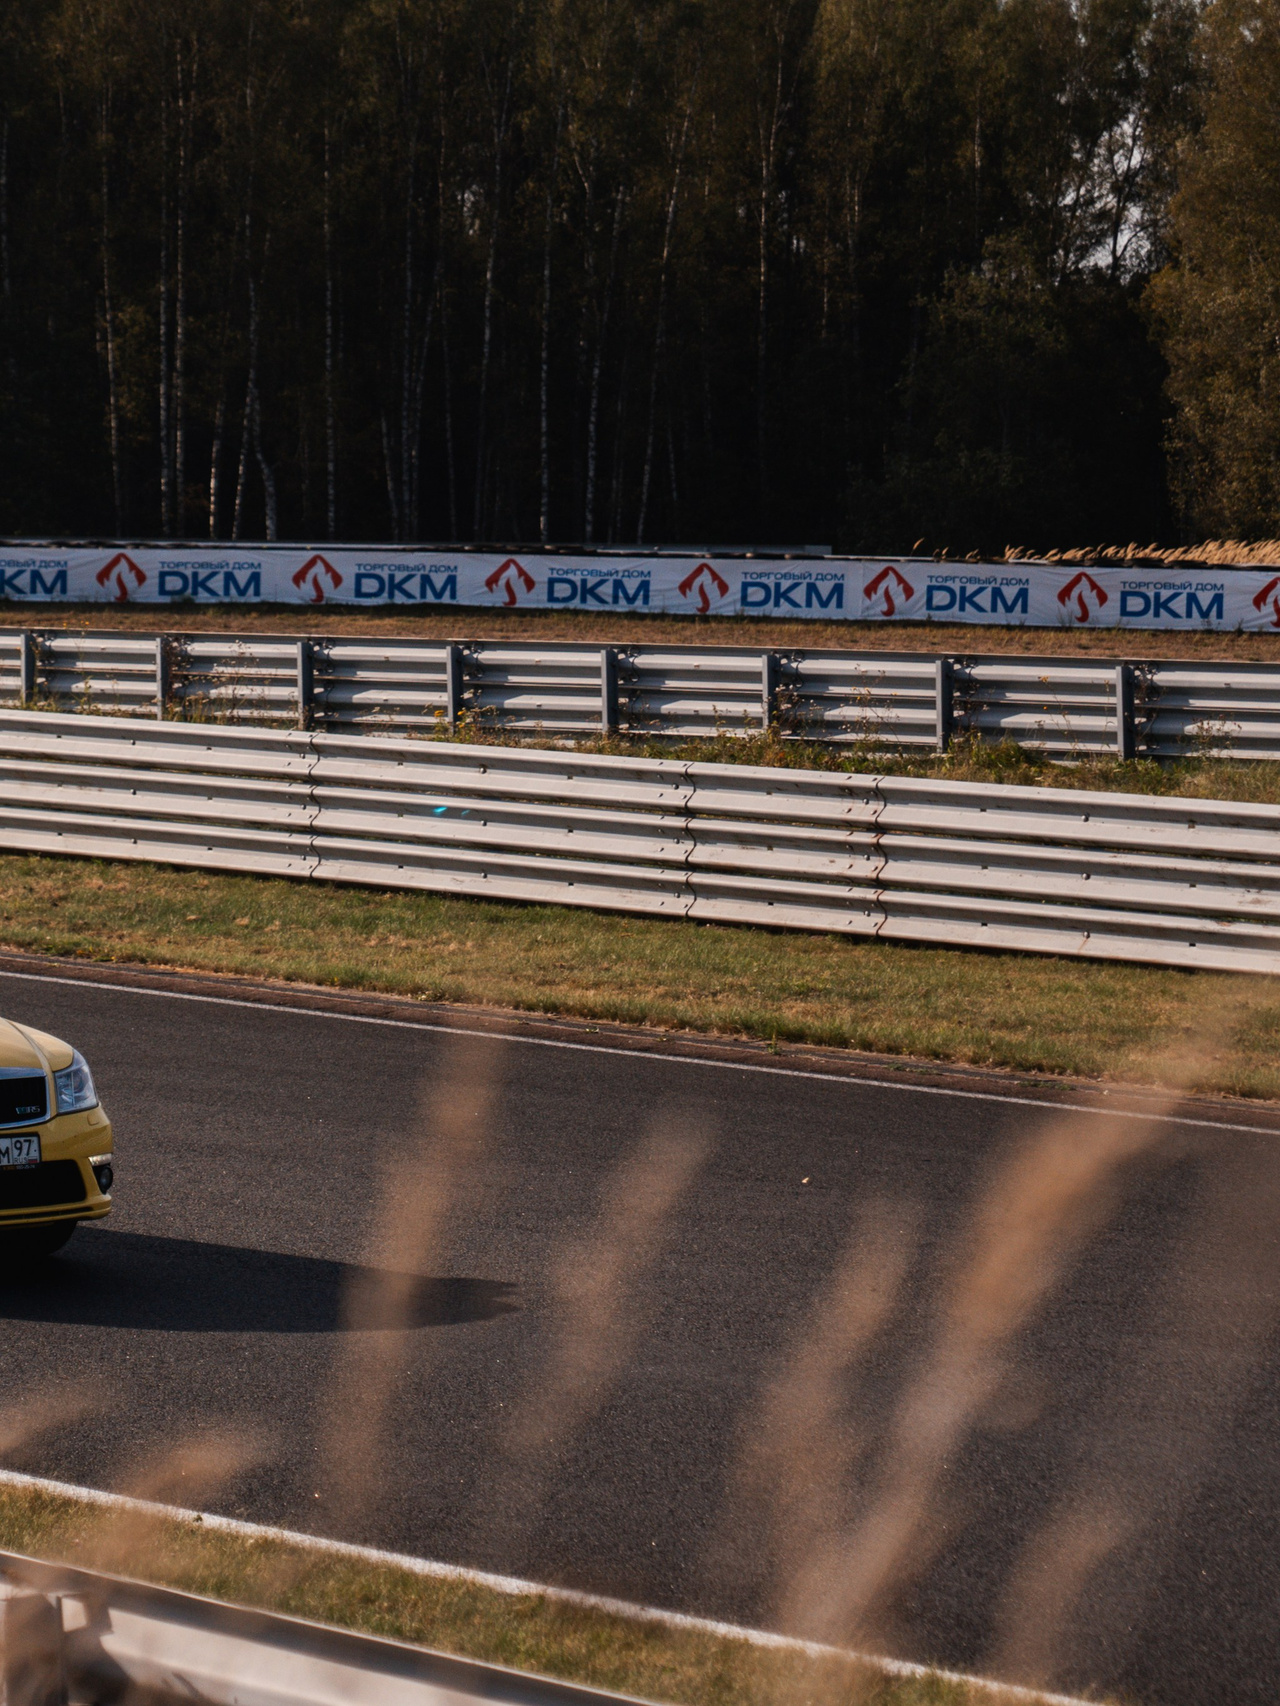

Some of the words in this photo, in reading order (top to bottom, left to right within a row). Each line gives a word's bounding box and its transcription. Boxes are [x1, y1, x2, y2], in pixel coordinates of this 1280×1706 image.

[39, 560, 69, 569] ДОМ
[159, 561, 229, 570] ТОРГОВЫЙ
[231, 562, 262, 571] ДОМ
[355, 563, 425, 572] ТОРГОВЫЙ
[428, 564, 458, 573] ДОМ
[548, 567, 618, 577] ТОРГОВЫЙ
[621, 569, 651, 579] ДОМ
[741, 572, 813, 581] ТОРГОВЫЙ
[815, 573, 845, 582] ДОМ
[158, 571, 261, 597] DKM
[354, 573, 457, 600] DKM
[927, 575, 997, 585] ТОРГОВЫЙ
[998, 577, 1029, 587] ДОМ
[1121, 581, 1192, 590] ТОРГОВЫЙ
[1193, 583, 1225, 592] ДОМ
[547, 576, 650, 605] DKM
[741, 582, 844, 608] DKM
[926, 584, 1028, 613] DKM
[1120, 590, 1223, 619] DKM
